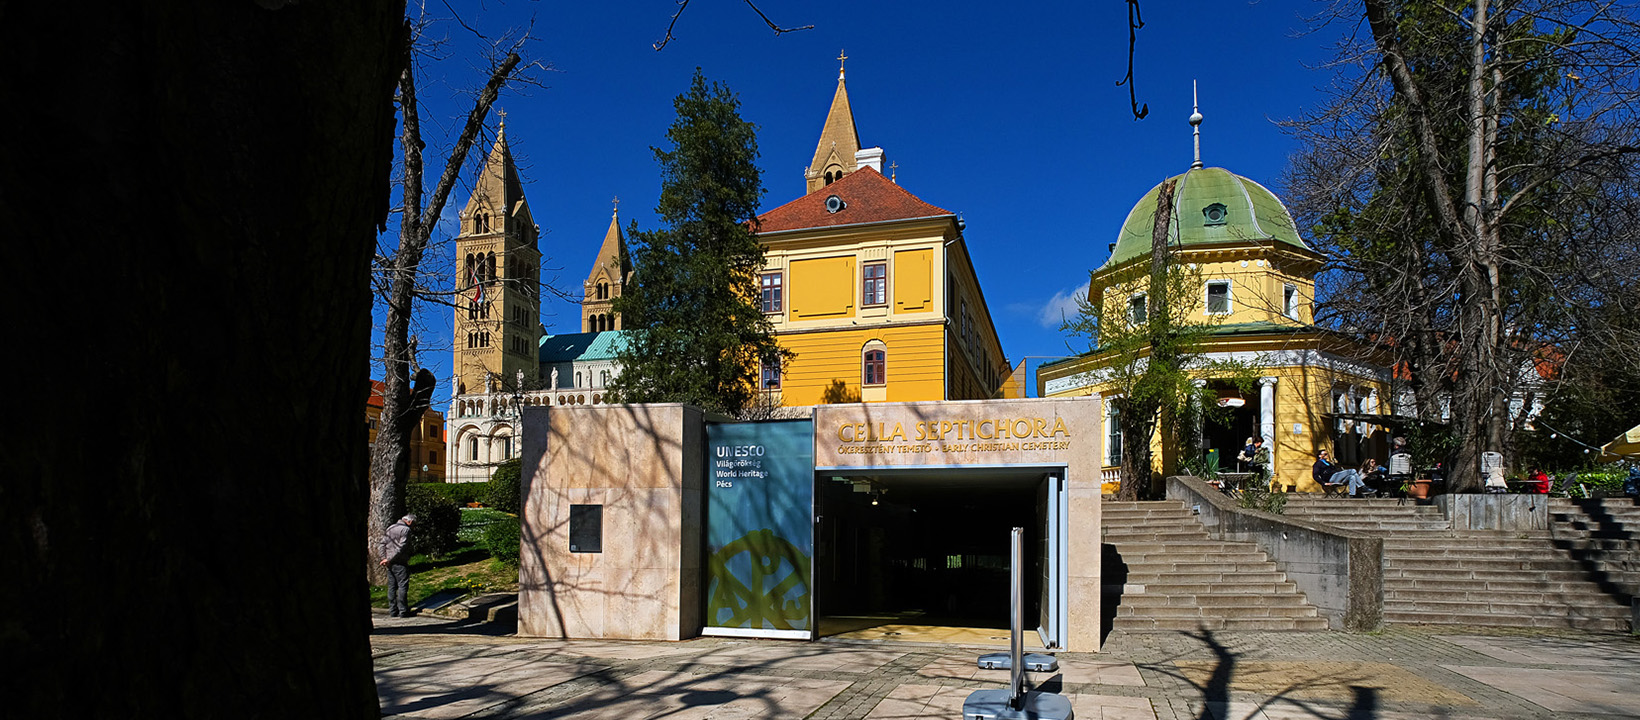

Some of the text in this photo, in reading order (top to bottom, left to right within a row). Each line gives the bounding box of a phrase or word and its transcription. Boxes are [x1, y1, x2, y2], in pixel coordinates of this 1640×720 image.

[838, 416, 1070, 442] CELLA SEPTICHORA
[717, 446, 765, 457] UNESCO
[837, 442, 1071, 455] ÓKERESZTÉNY TEMETŐ EARLY CHRISTIAN CEMETERY
[716, 460, 761, 468] Világörökség
[716, 470, 768, 478] World Heritage
